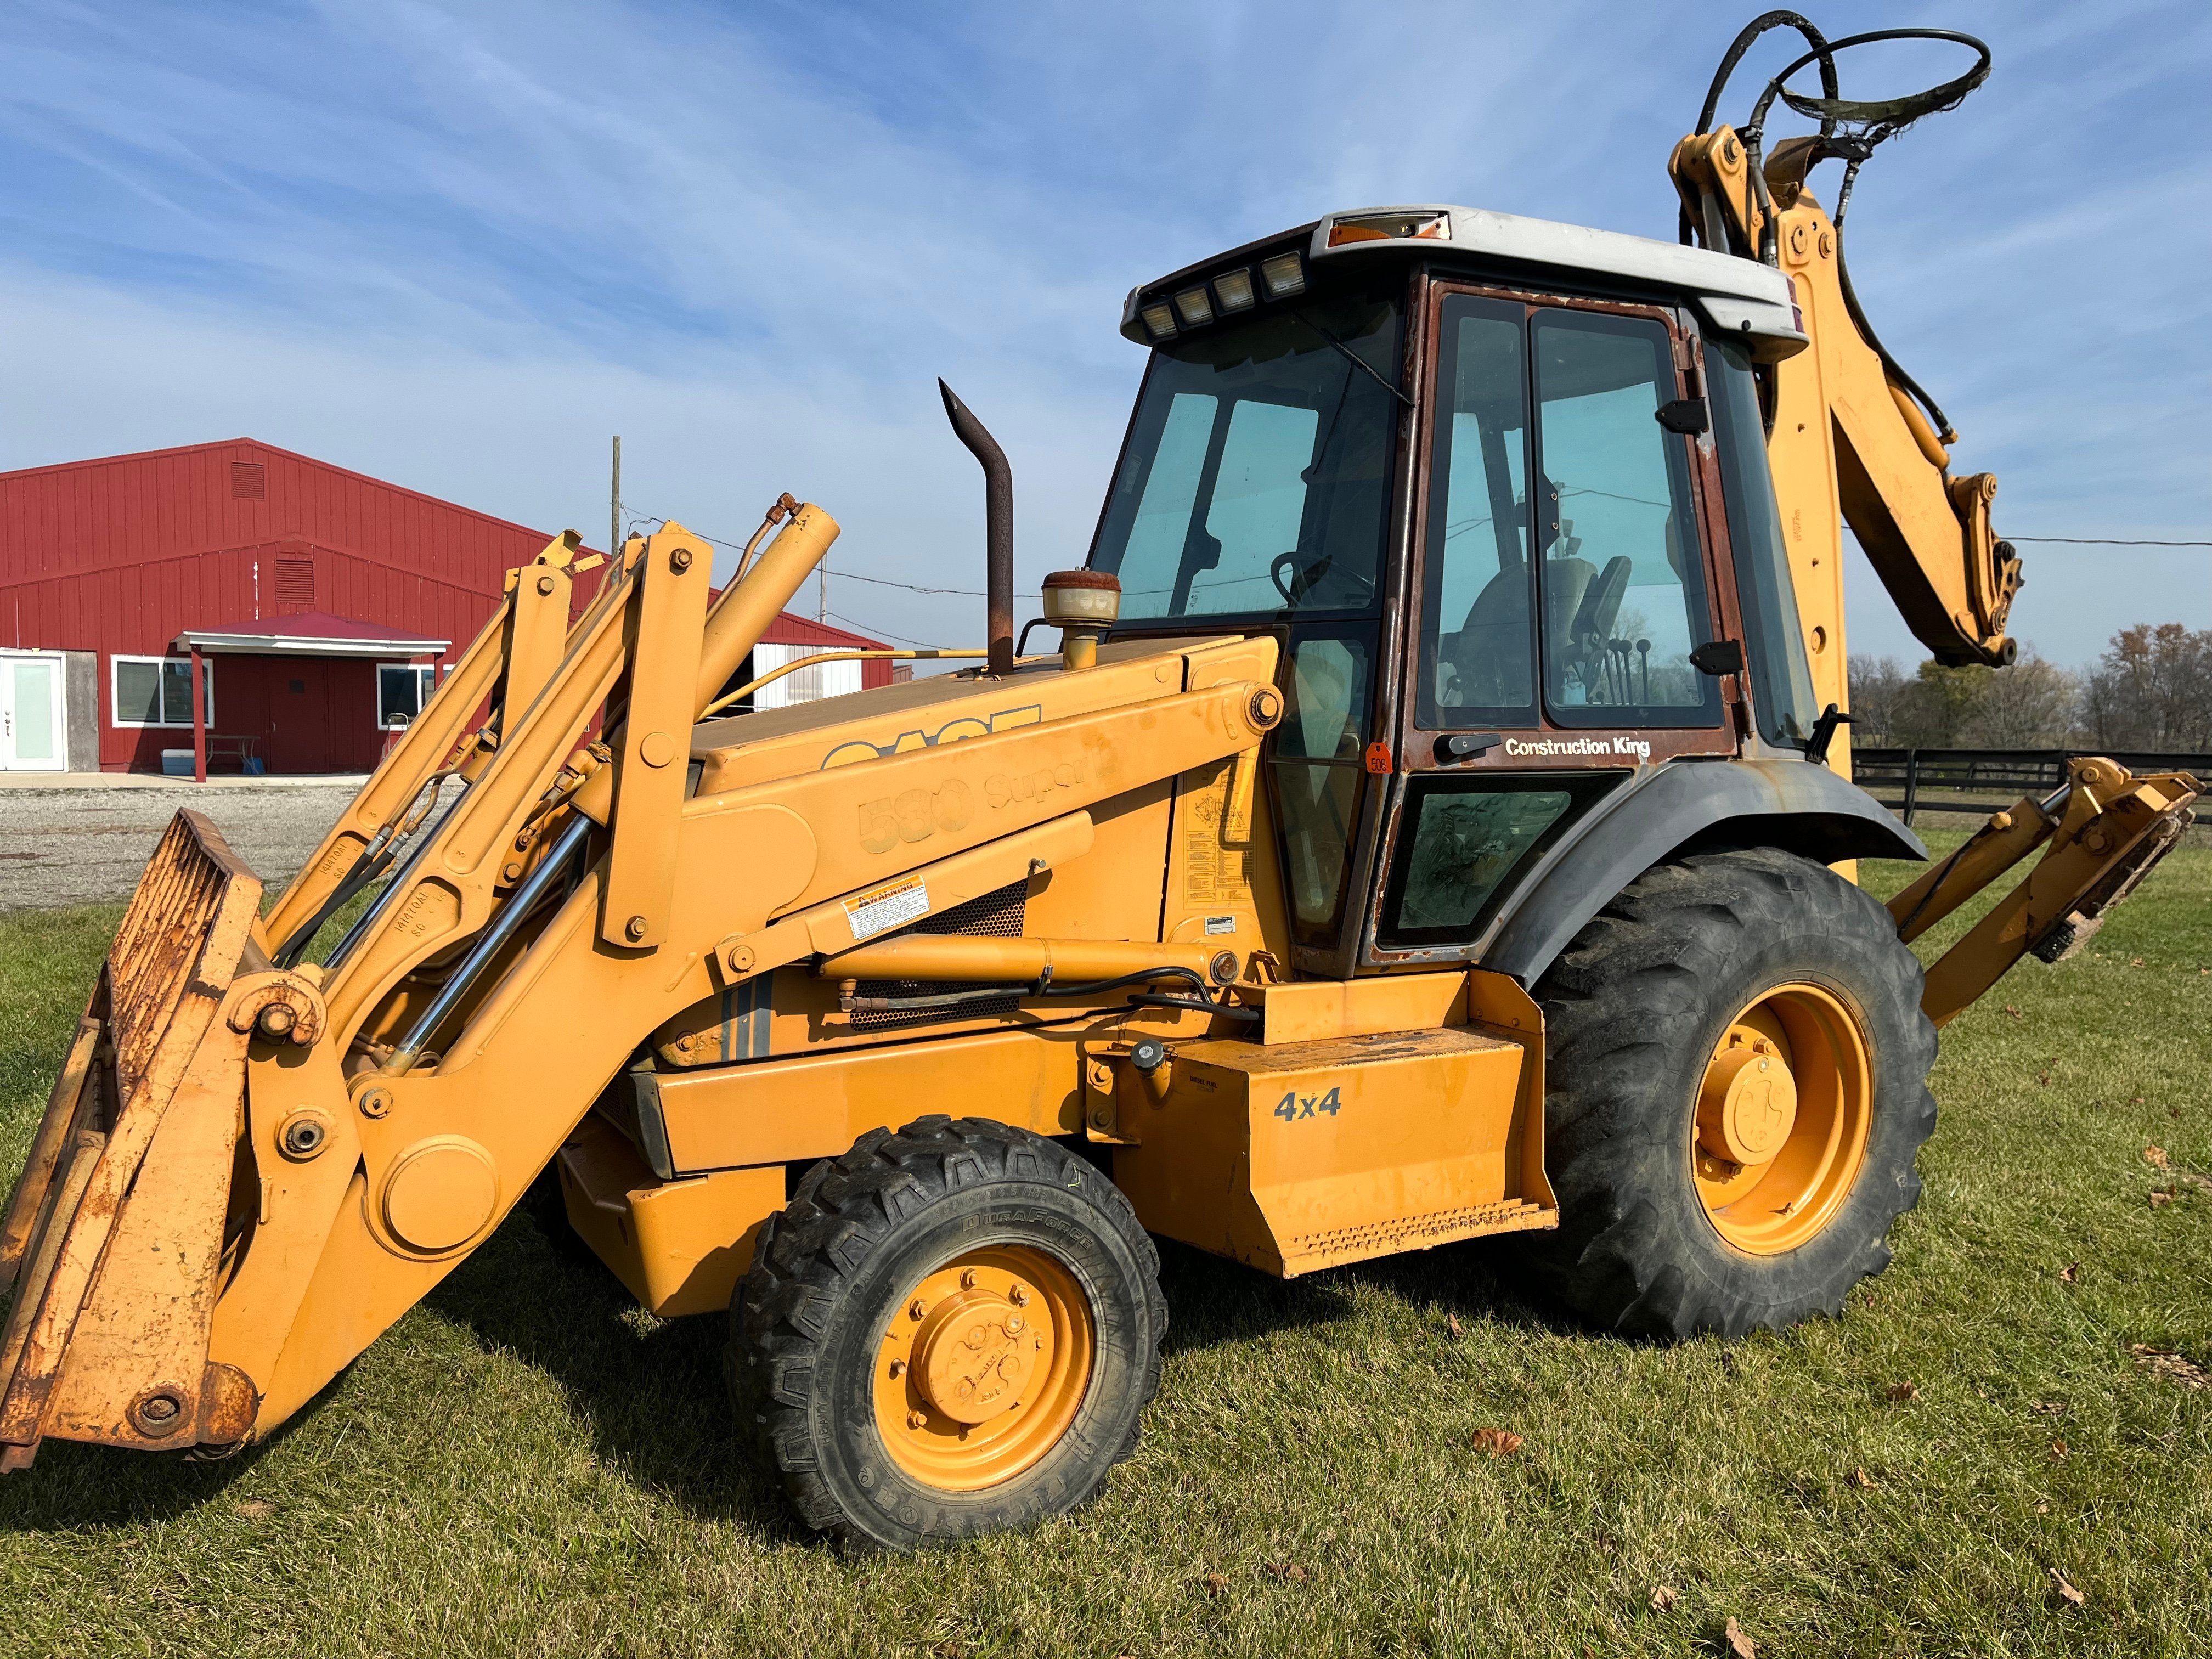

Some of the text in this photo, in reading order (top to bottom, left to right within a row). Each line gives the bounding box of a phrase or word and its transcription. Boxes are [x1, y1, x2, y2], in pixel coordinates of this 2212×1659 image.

[1505, 737, 1650, 757] Construction King
[859, 779, 974, 854] 580
[984, 755, 1089, 809] Super
[394, 892, 429, 932] 141470A1
[870, 882, 914, 904] WARNING
[1190, 1075, 1206, 1086] DIESEL
[1206, 1080, 1218, 1089] FUEL
[1274, 1087, 1341, 1122] 4x4
[828, 1268, 876, 1352] INDUSTRIAL
[817, 1355, 834, 1393] DUTY
[814, 1402, 831, 1446] HEAVY
